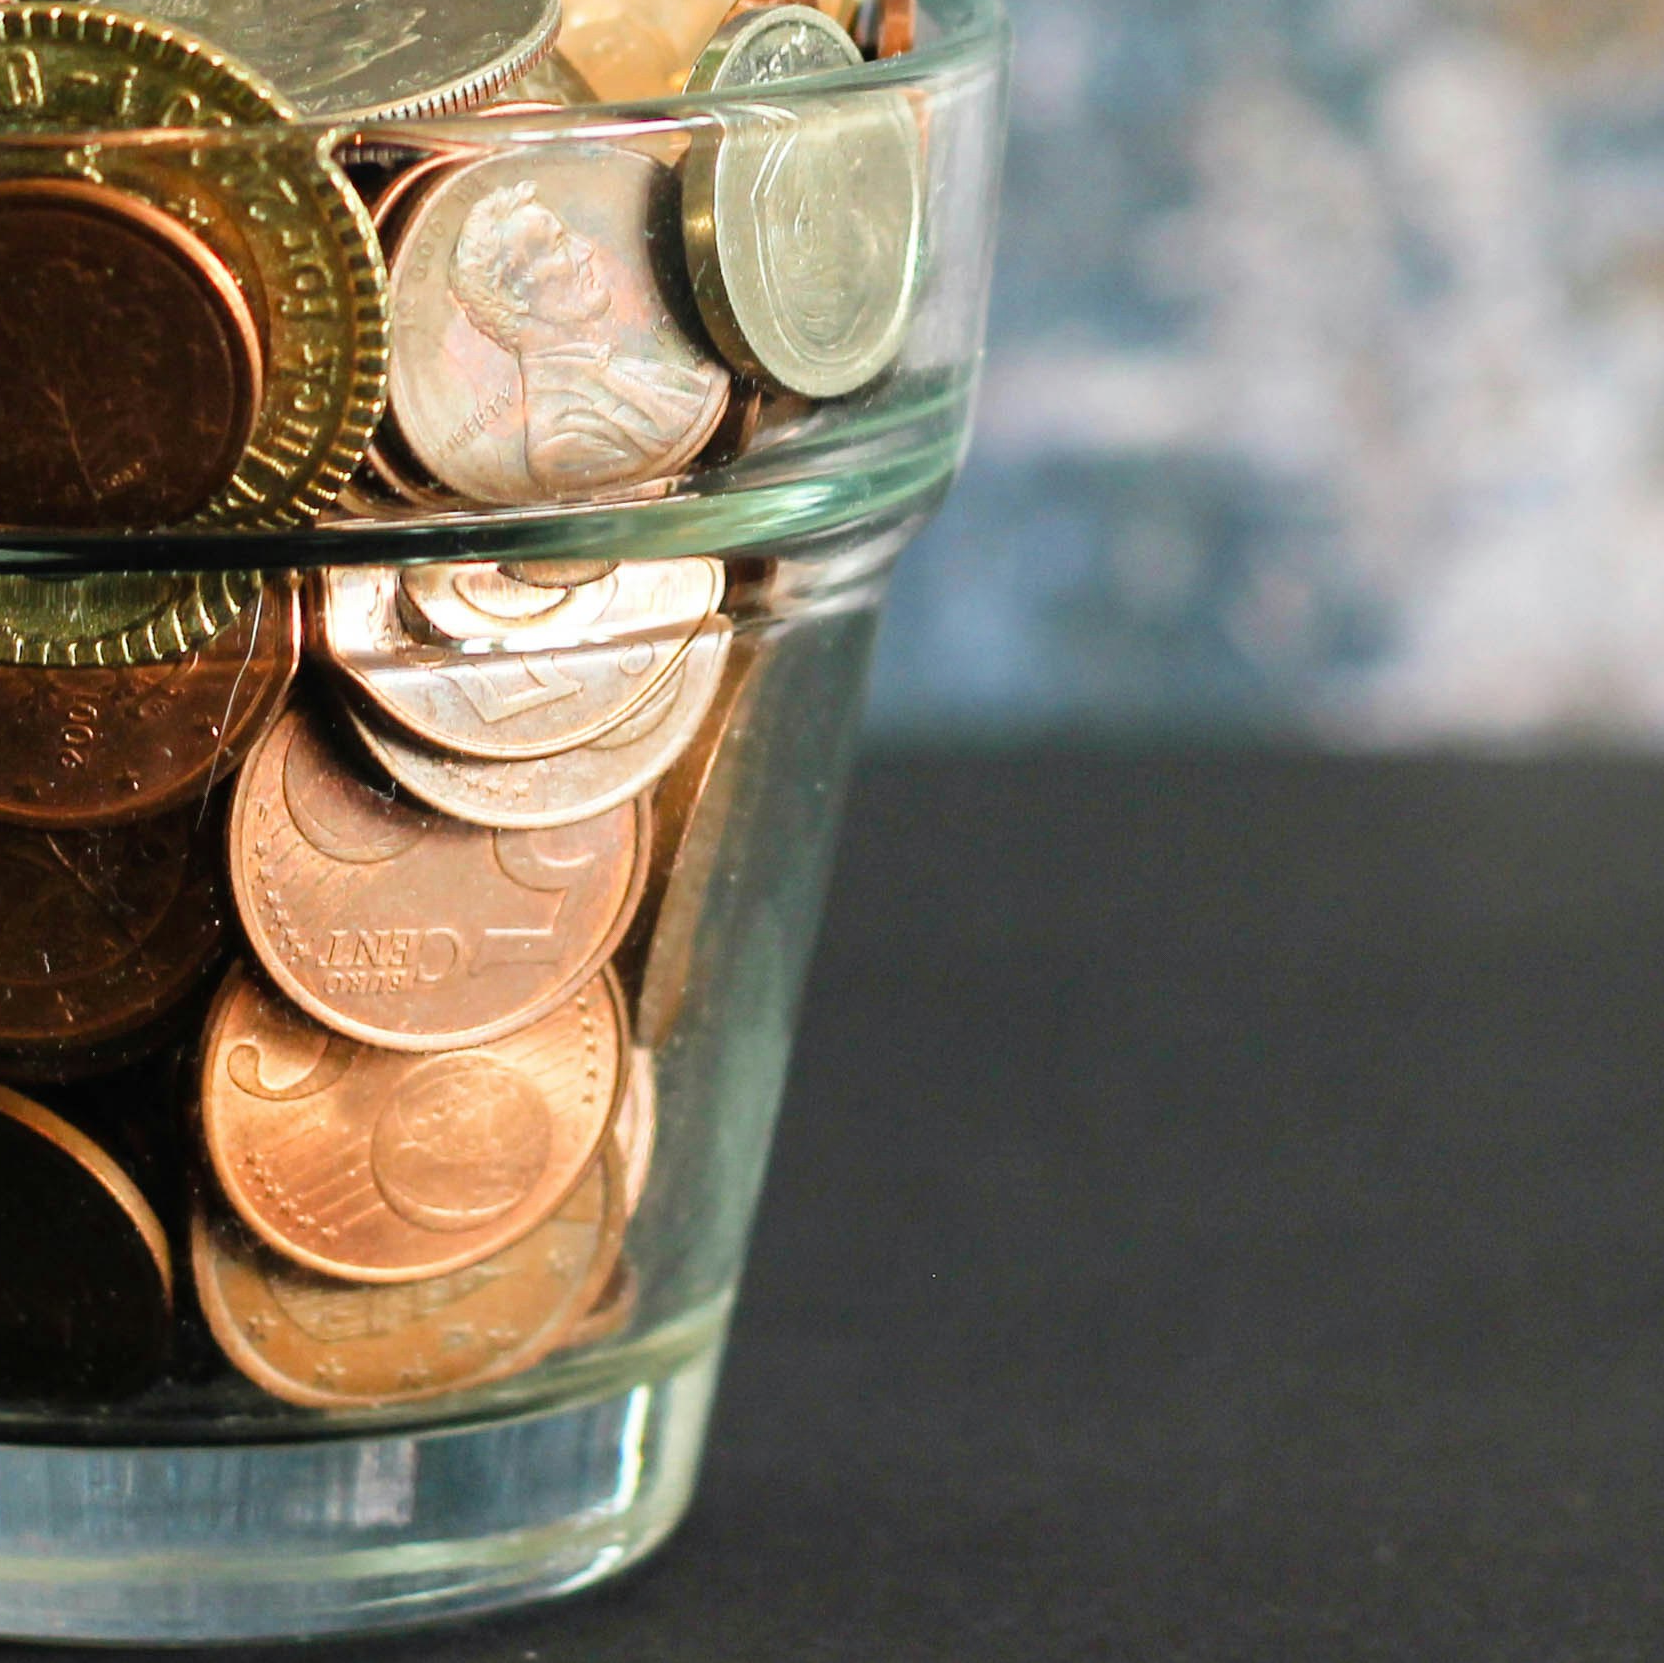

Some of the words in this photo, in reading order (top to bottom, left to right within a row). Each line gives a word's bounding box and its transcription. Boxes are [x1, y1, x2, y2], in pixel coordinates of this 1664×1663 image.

[436, 383, 514, 462] LIBERTY
[316, 925, 465, 982] CENT
[322, 969, 408, 995] EURO
